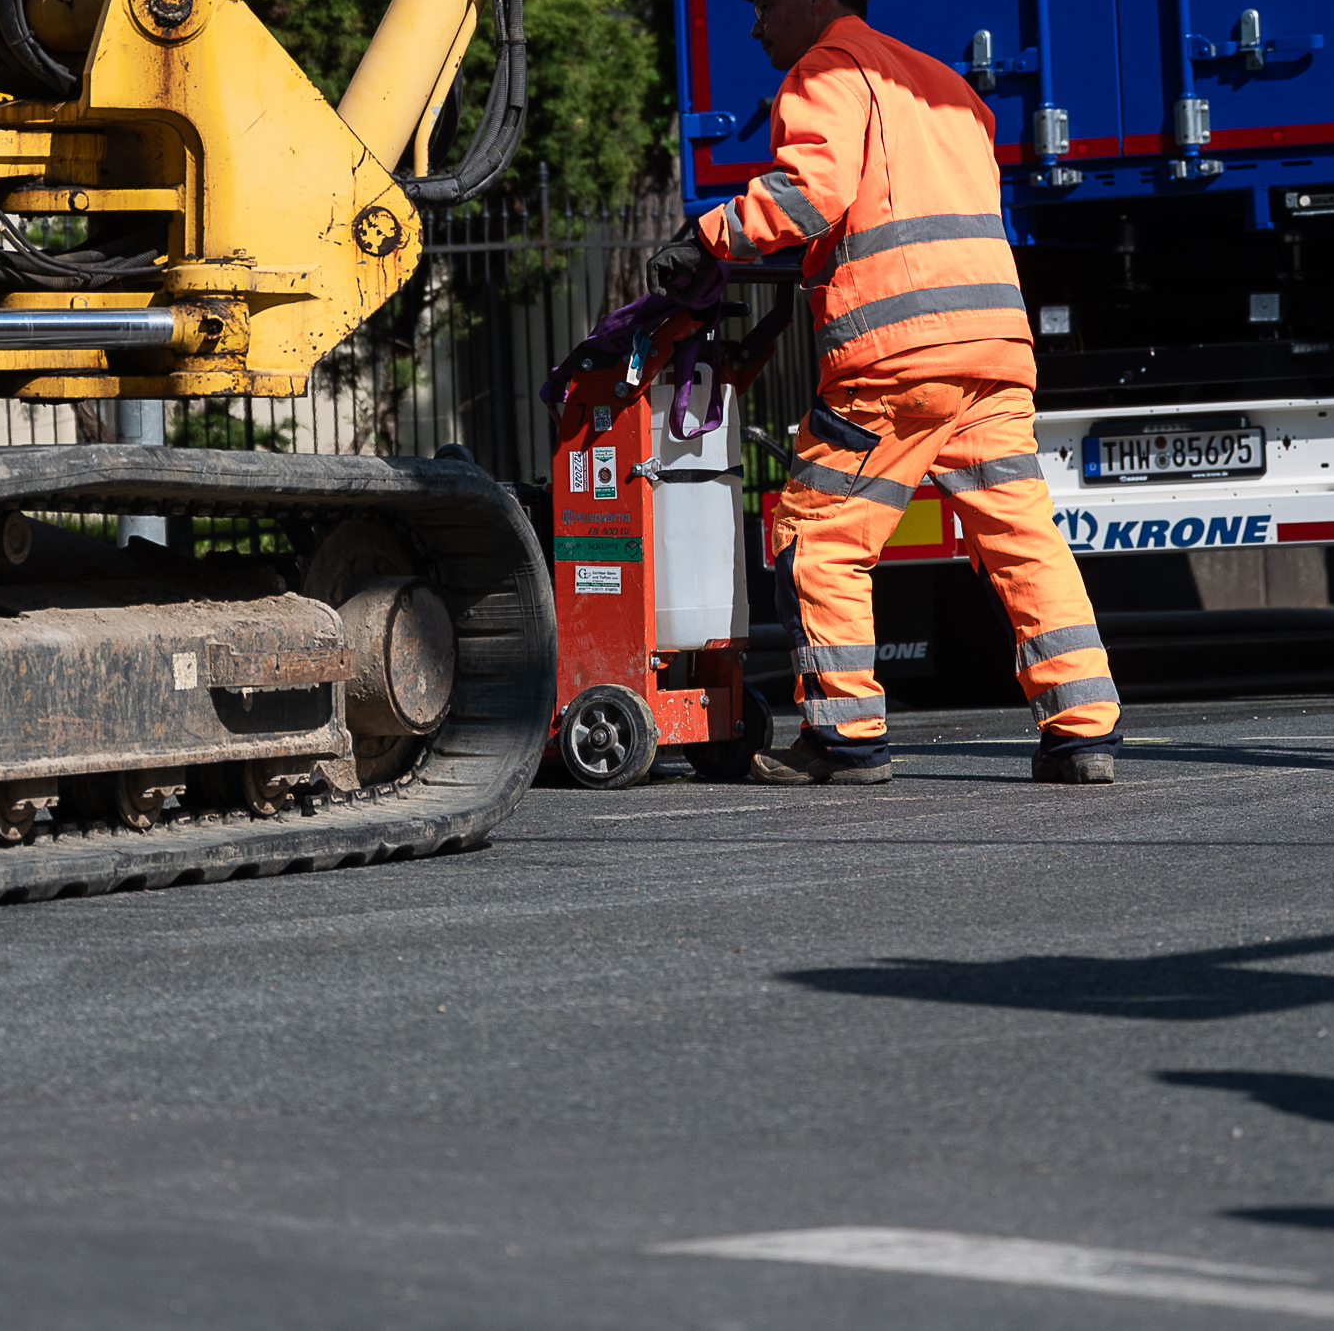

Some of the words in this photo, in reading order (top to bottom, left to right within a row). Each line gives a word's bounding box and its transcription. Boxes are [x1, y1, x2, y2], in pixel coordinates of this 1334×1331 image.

[1102, 439, 1151, 471] THW
[1172, 434, 1252, 468] 85695
[573, 510, 632, 525] Husqvarna
[1102, 514, 1273, 551] KRONE
[876, 641, 929, 661] ONE
